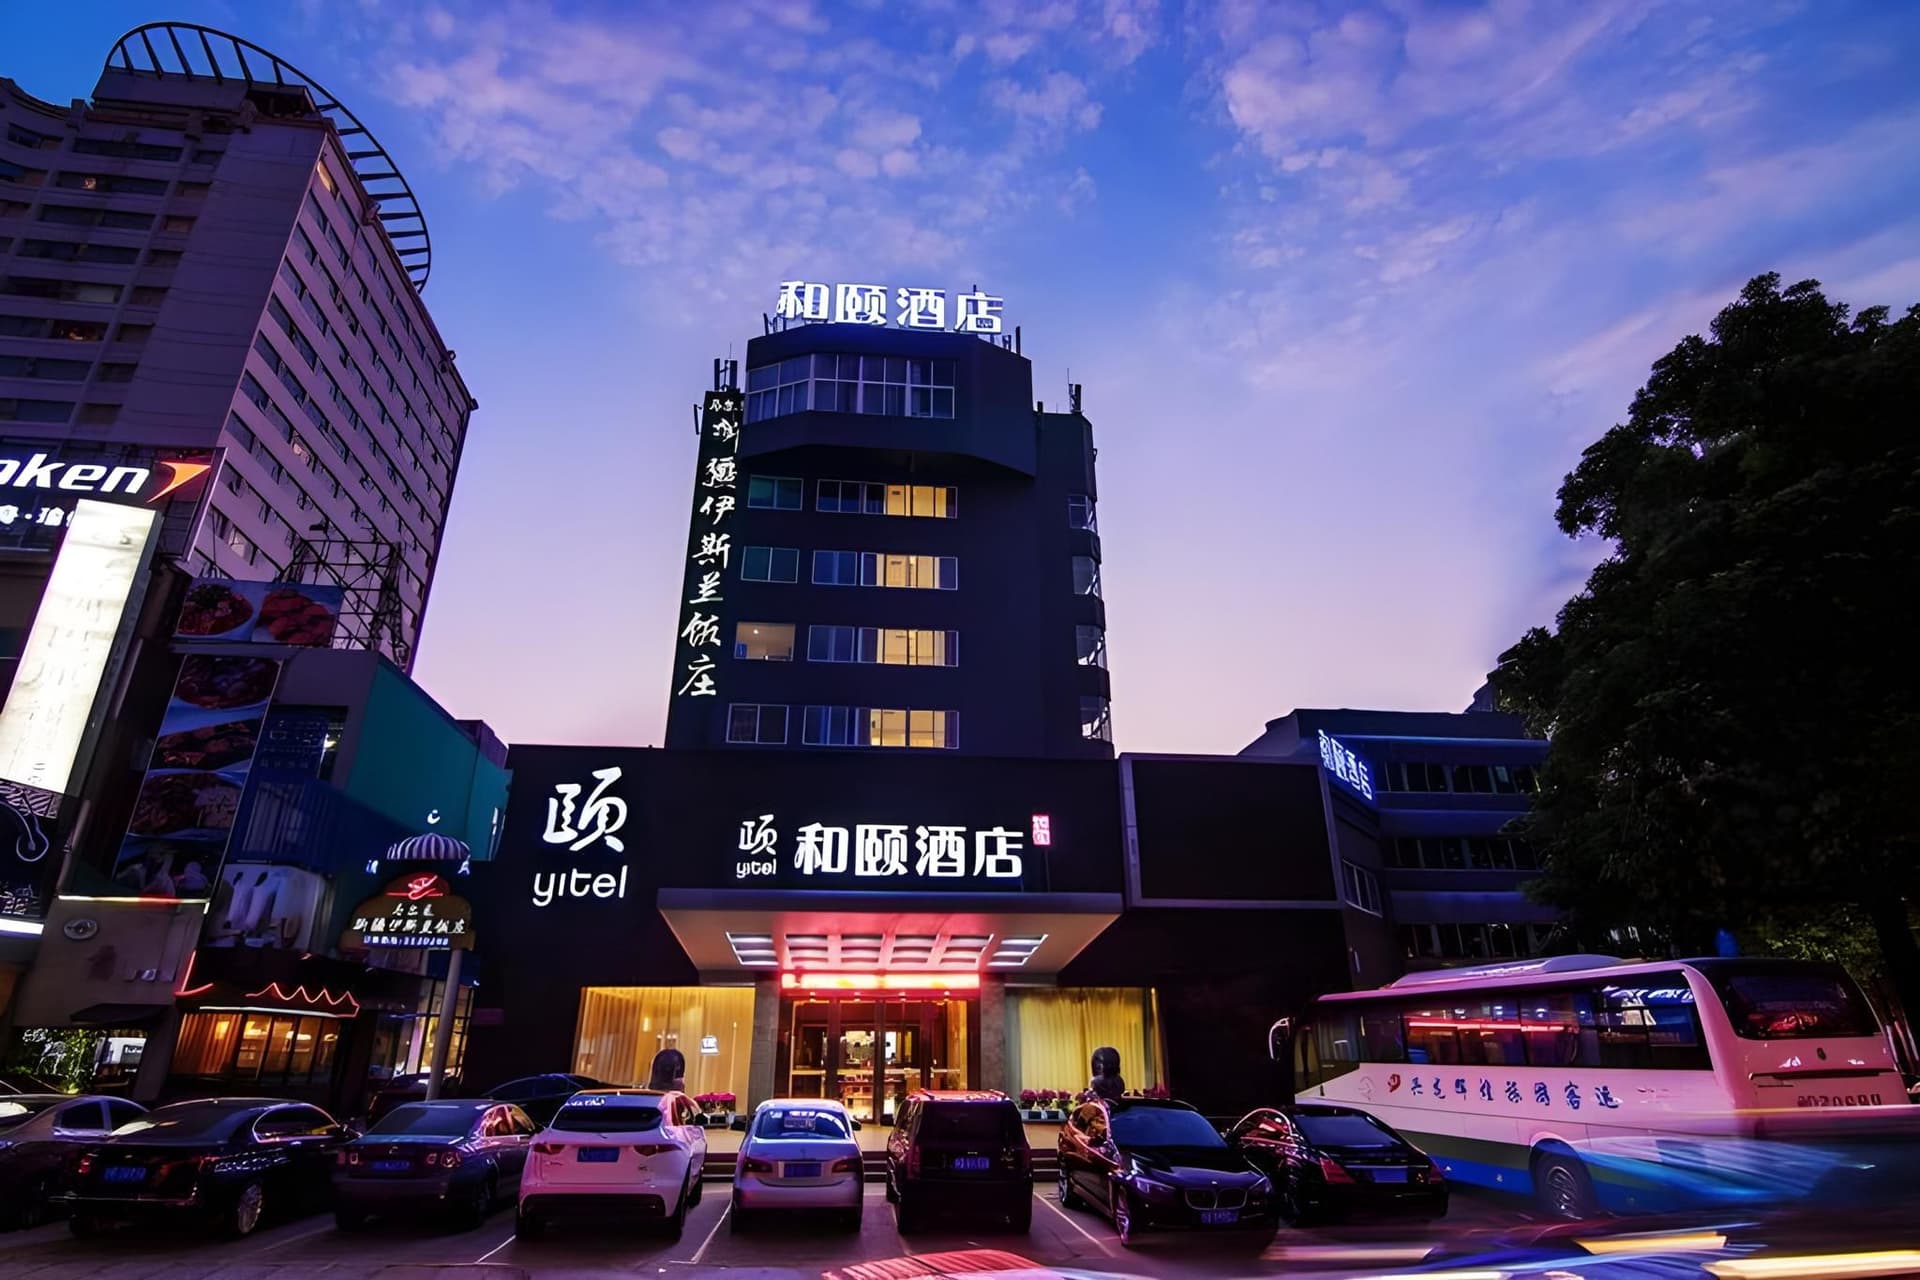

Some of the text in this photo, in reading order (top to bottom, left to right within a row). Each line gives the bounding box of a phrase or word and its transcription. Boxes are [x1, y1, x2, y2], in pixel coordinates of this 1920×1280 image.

[776, 280, 1003, 333] 和颐酒店
[678, 417, 740, 696] 新疆伊斯兰饭庄
[736, 858, 777, 879] yitel
[794, 822, 1024, 878] 和颐酒店
[532, 865, 628, 907] yitel
